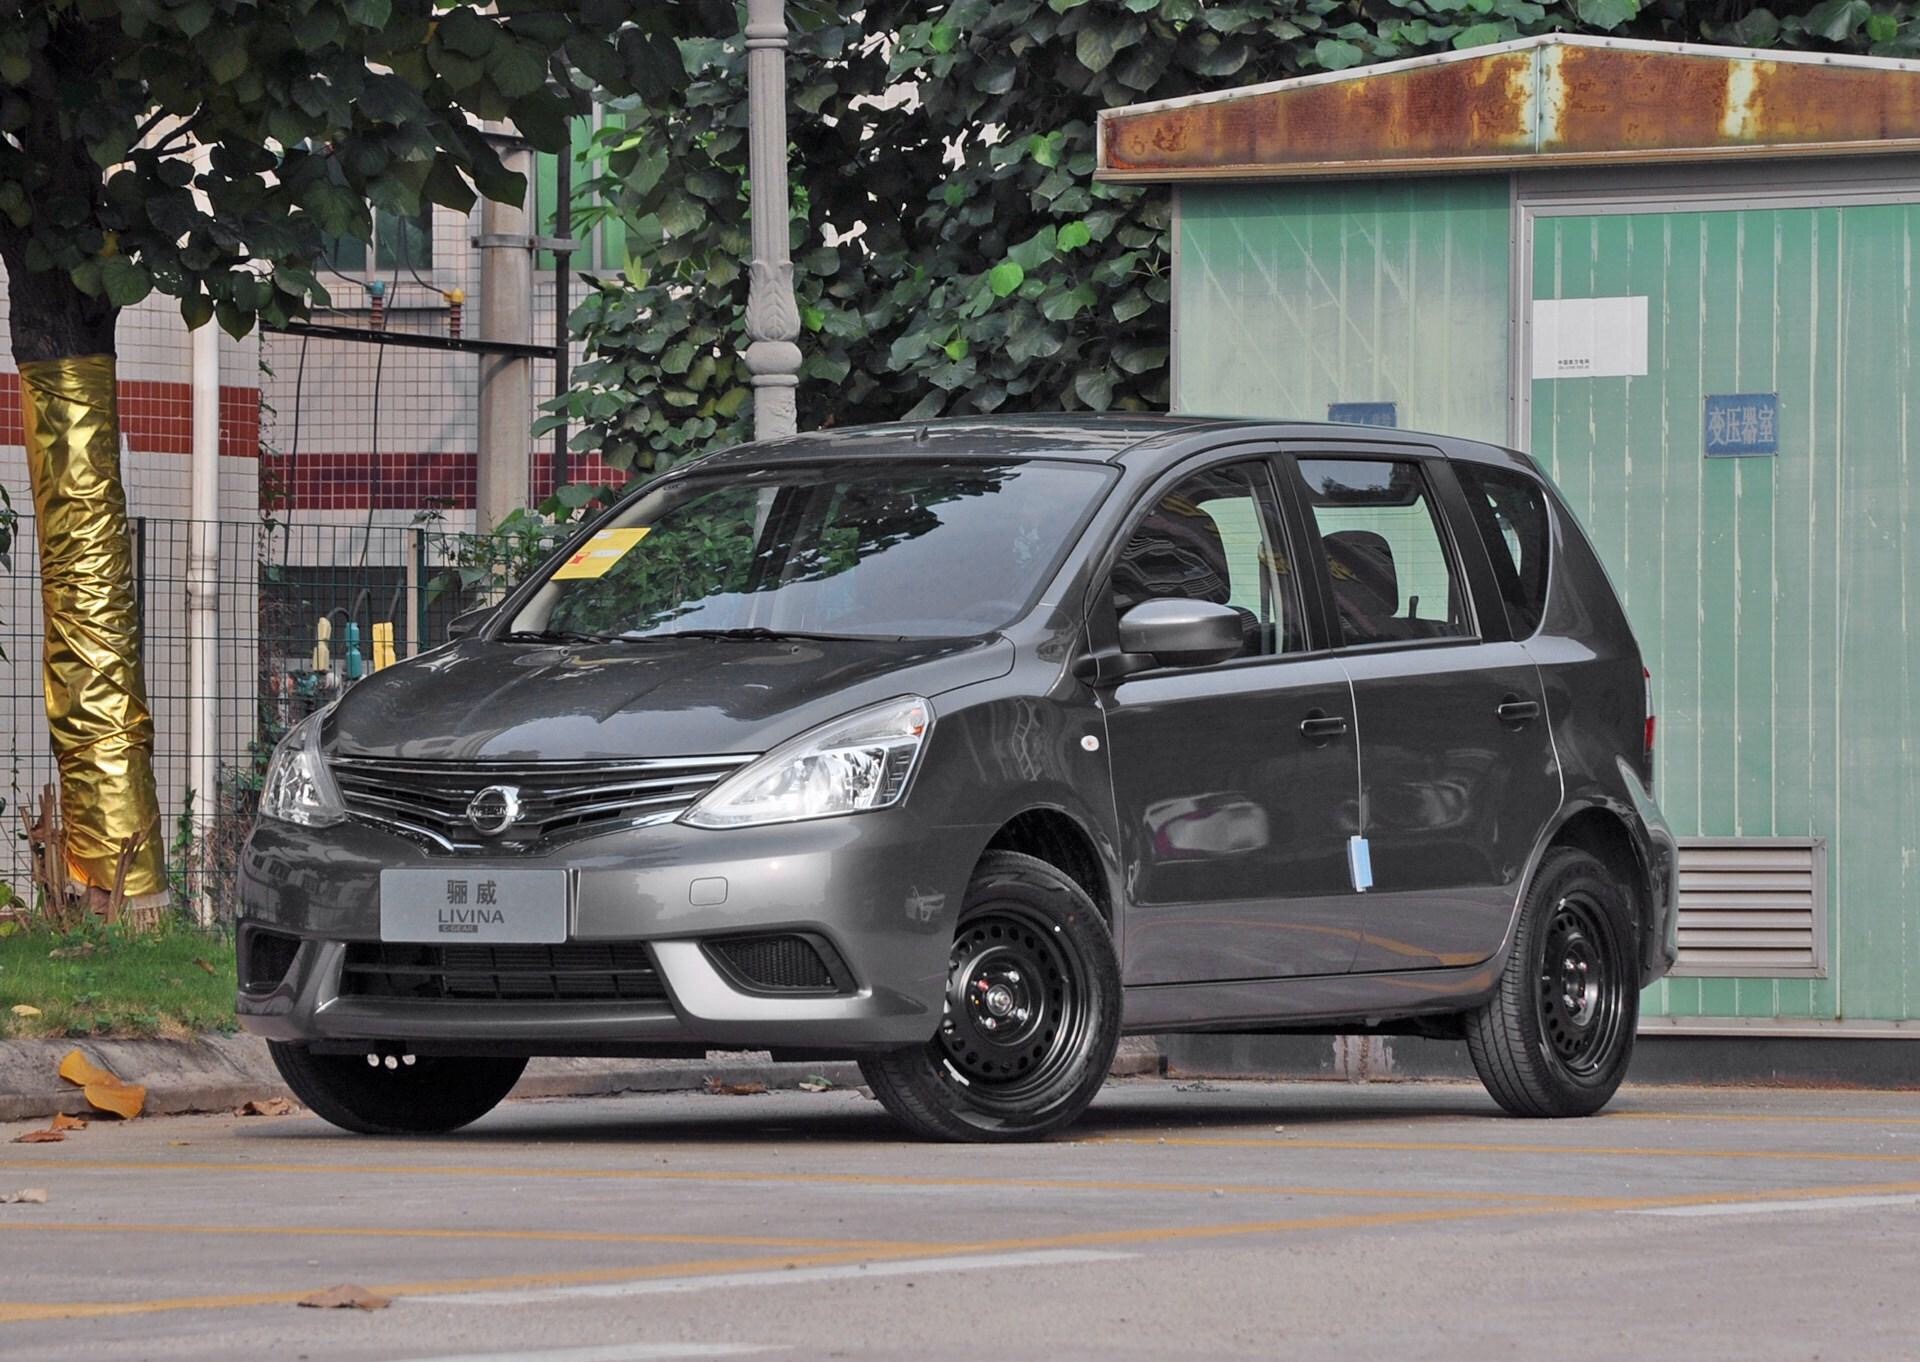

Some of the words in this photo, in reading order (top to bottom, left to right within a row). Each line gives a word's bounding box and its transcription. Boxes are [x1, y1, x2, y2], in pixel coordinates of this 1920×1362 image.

[1708, 404, 1775, 446] 变压器室
[446, 879, 497, 905] 骊威
[438, 909, 505, 924] LIVINA
